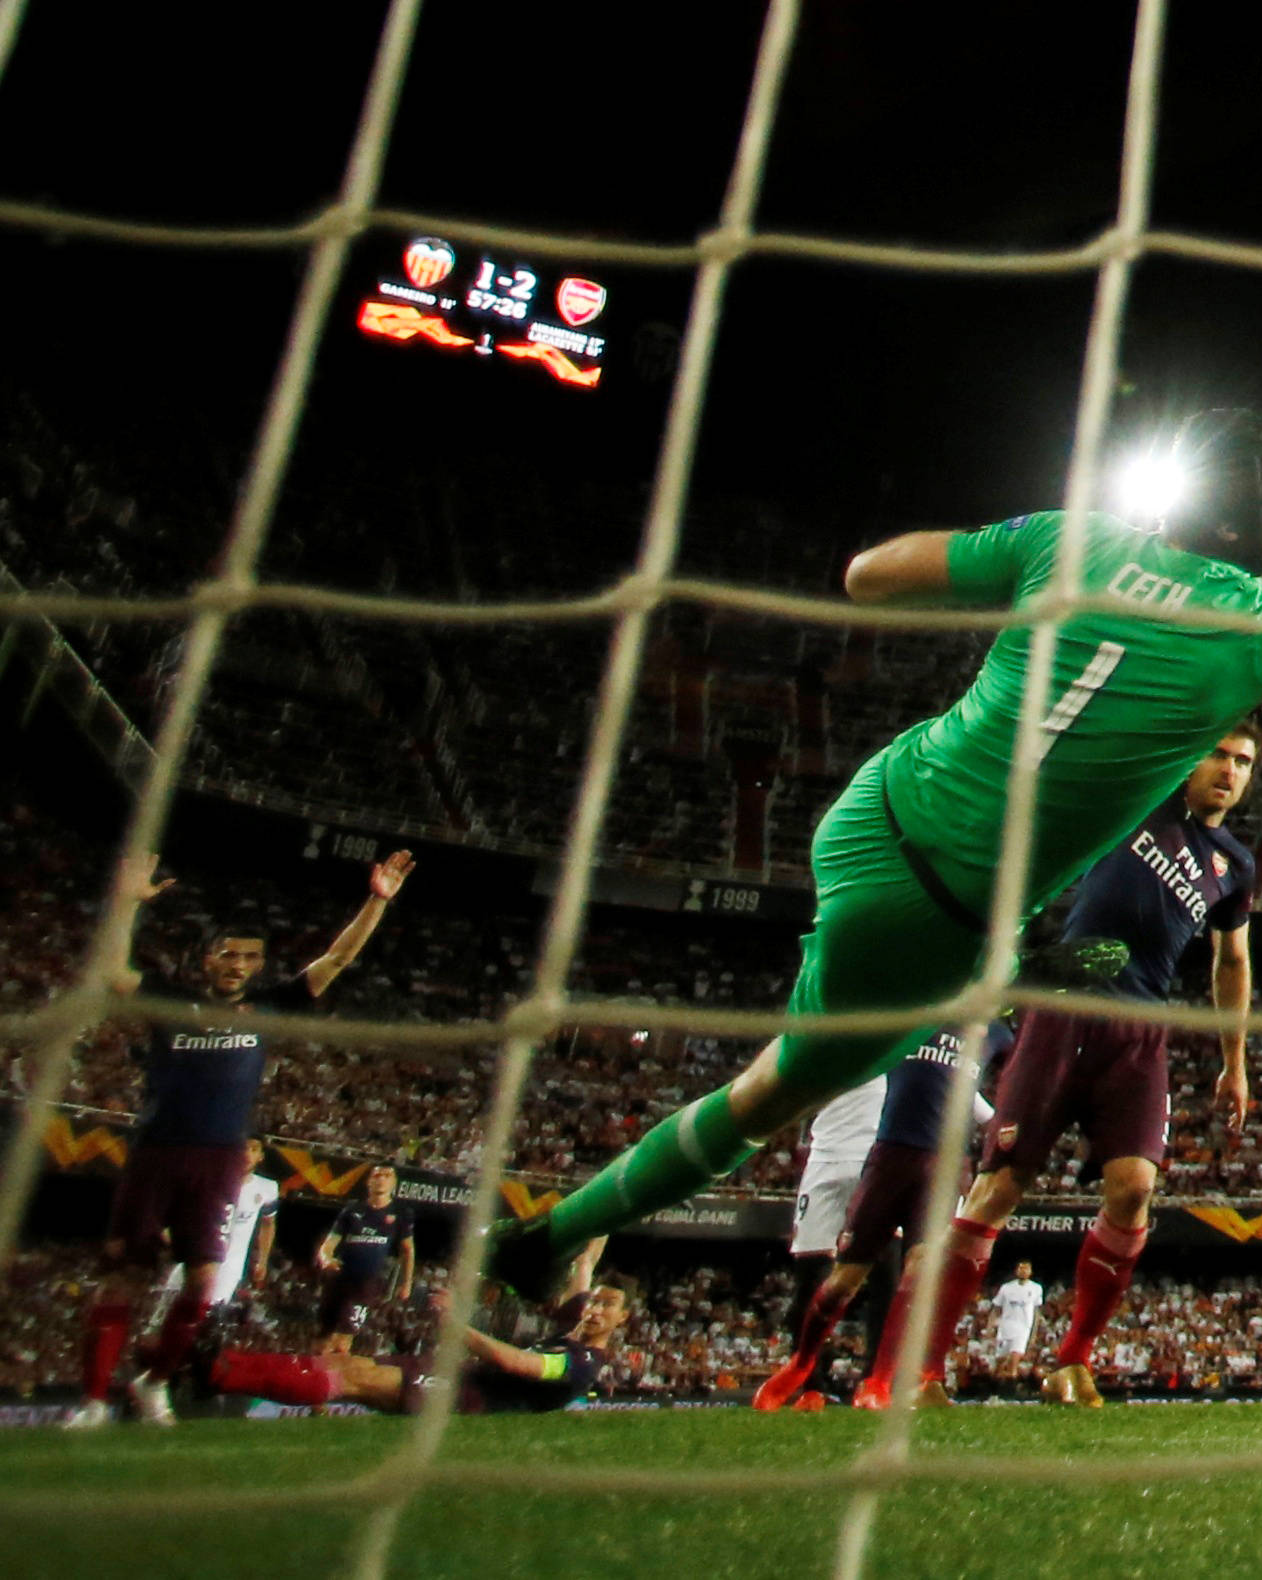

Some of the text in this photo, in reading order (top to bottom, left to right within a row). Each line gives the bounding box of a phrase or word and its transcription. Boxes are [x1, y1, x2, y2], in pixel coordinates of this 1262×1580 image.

[475, 260, 537, 301] 1-2
[378, 282, 436, 306] GAMEIRO
[467, 289, 528, 319] 57:26
[712, 887, 760, 912] 1999
[441, 1186, 474, 1206] LEAG
[1005, 1215, 1074, 1232] GETHER
